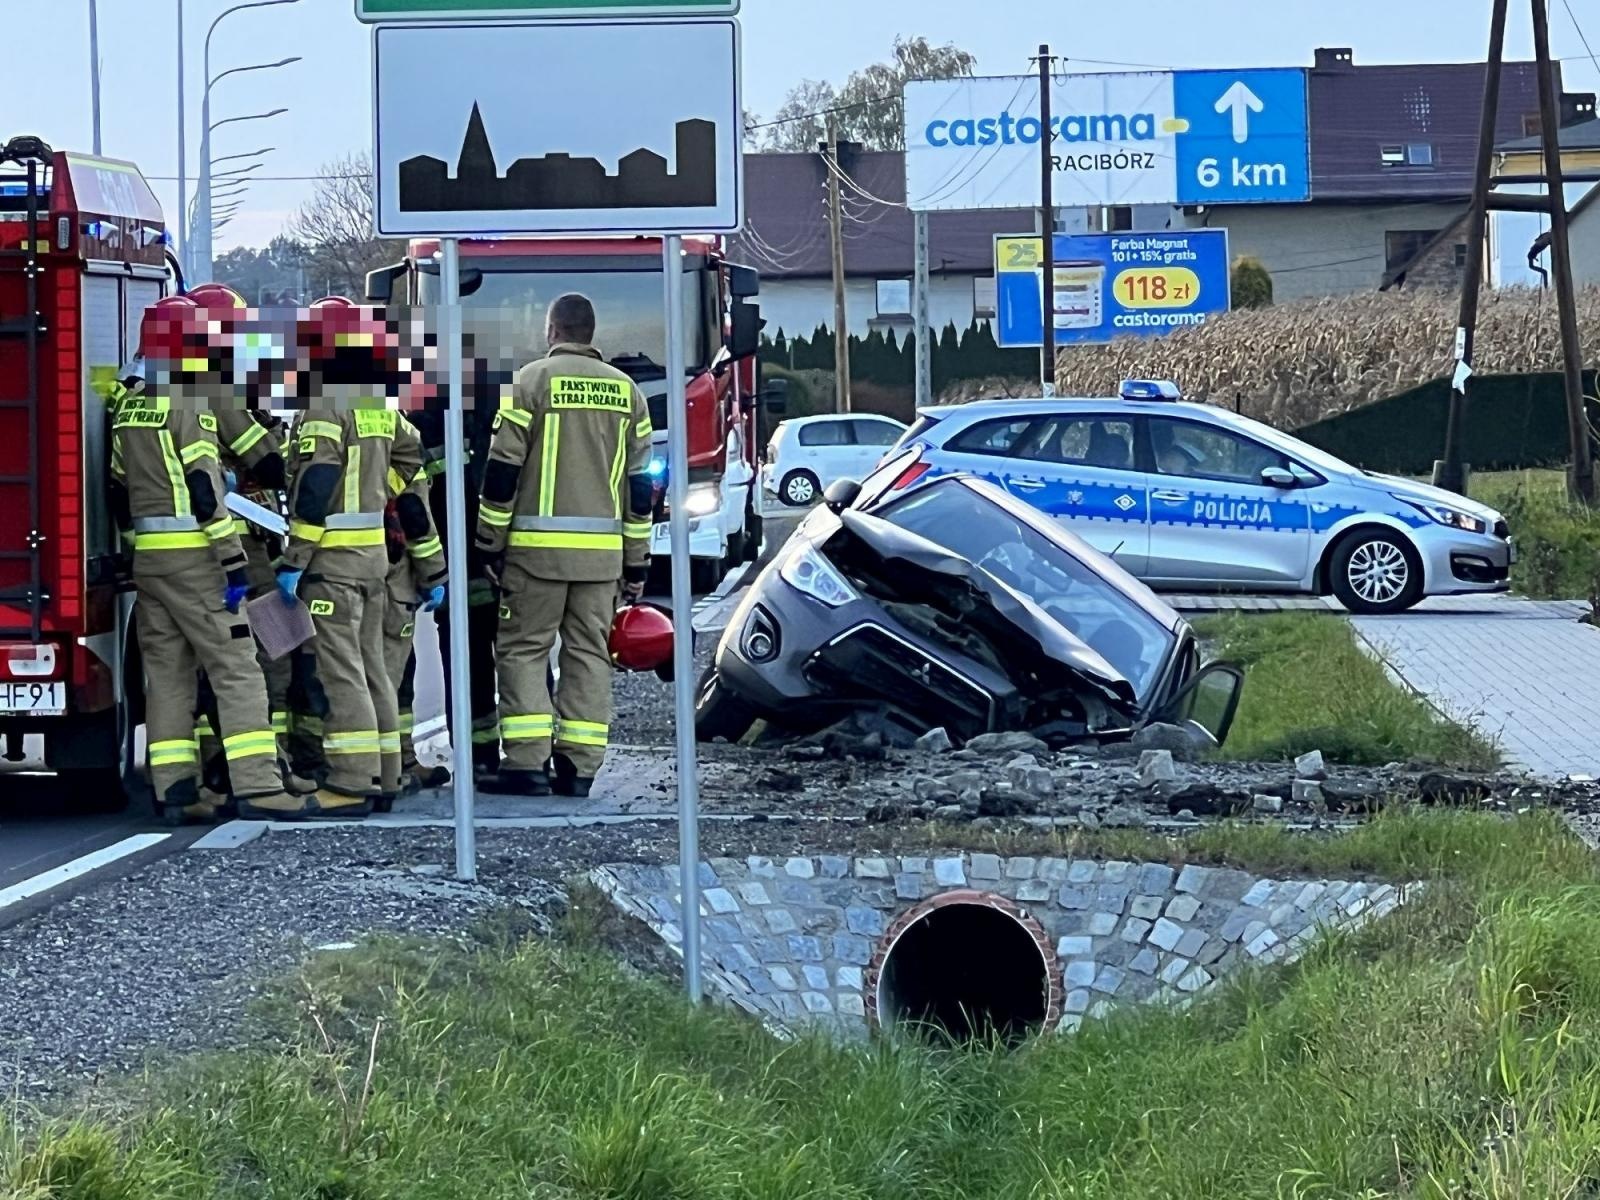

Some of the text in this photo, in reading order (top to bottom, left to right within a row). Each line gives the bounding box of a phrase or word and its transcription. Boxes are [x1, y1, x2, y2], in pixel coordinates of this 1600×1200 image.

[1050, 150, 1155, 171] RACIBÓRZ
[1197, 157, 1286, 188] 6 km
[1111, 238, 1188, 251] Farba Magnat
[1164, 250, 1197, 264] gratis
[1123, 275, 1190, 301] 118 zł
[1113, 312, 1206, 328] castorama
[1193, 500, 1272, 523] POLICJA
